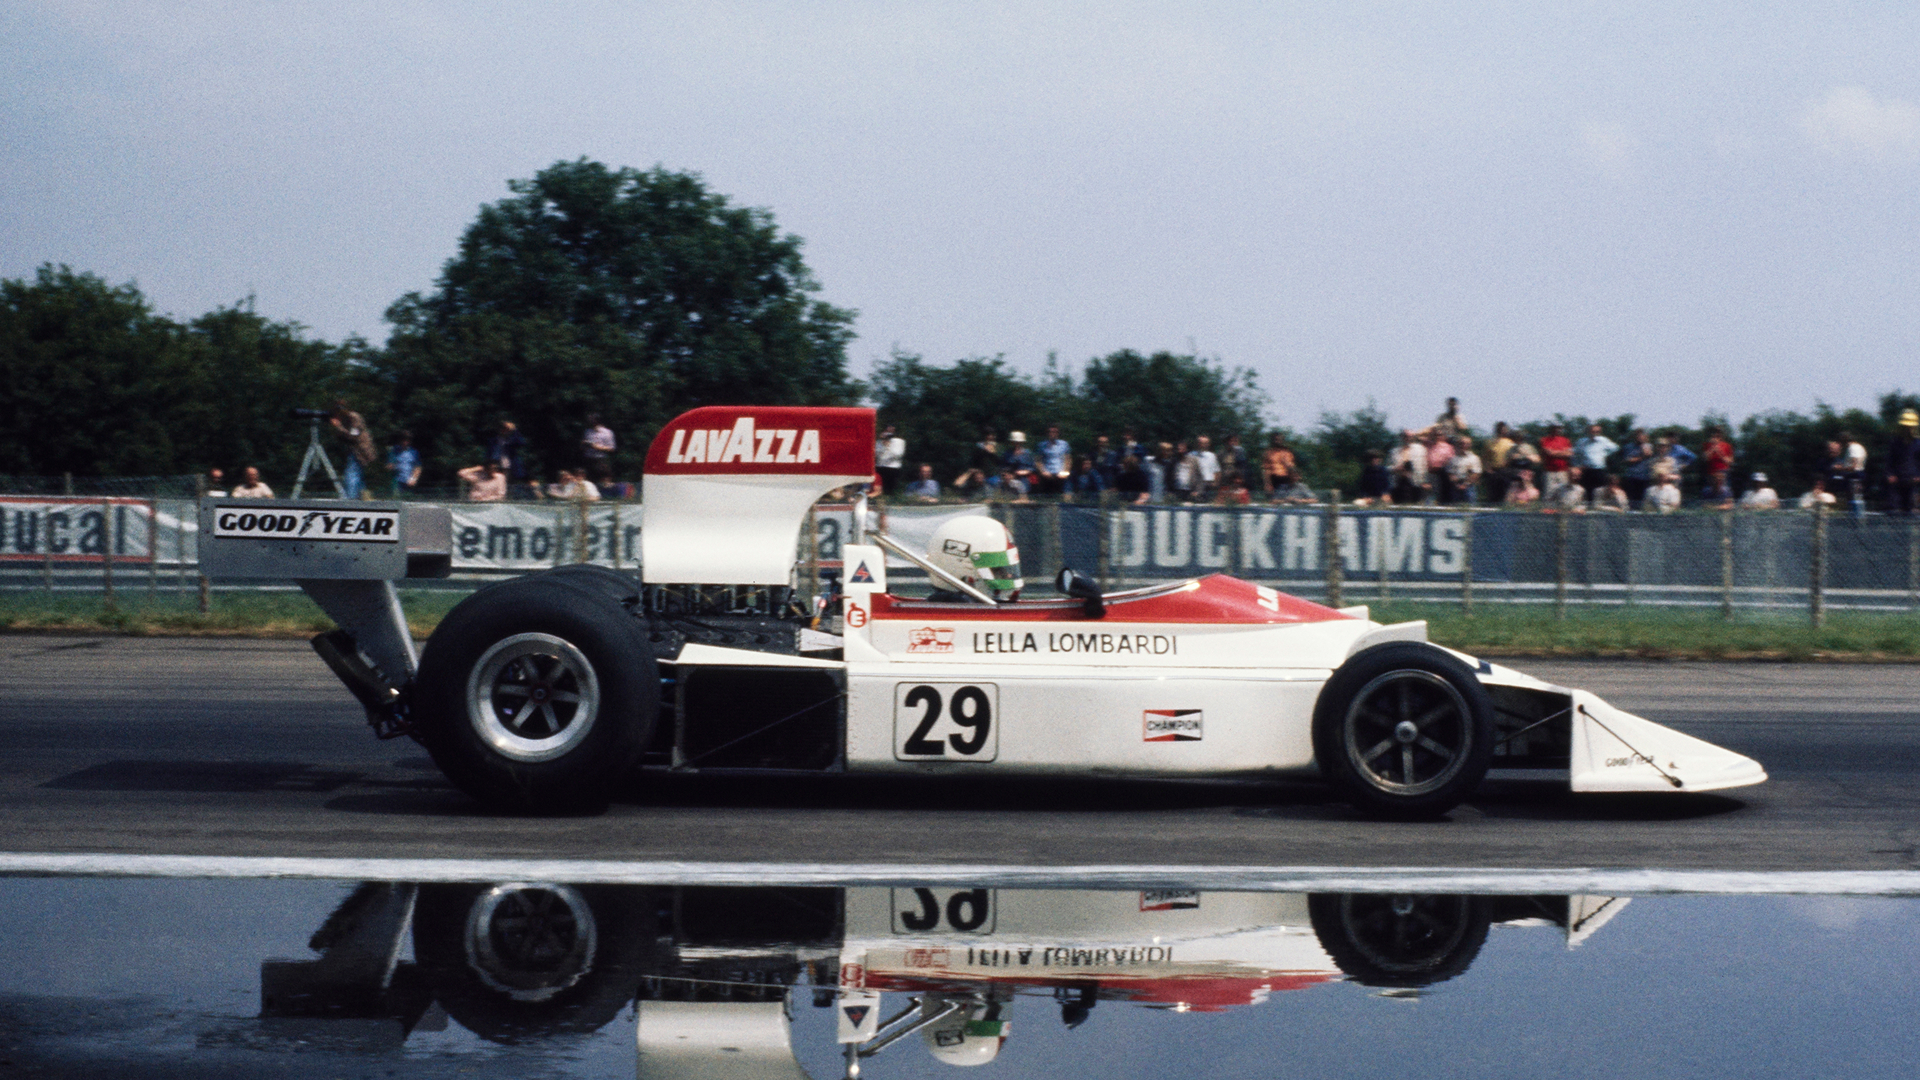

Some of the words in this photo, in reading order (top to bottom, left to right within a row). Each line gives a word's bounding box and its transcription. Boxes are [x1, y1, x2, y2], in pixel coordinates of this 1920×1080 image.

[666, 417, 820, 463] LAVAZZA
[0, 506, 126, 554] ucal
[1109, 510, 1466, 573] DUCKHAMS
[973, 632, 1038, 653] LELLA
[1049, 633, 1178, 655] LOMBARDI
[904, 685, 991, 756] 29
[1146, 720, 1201, 731] CHAMPION
